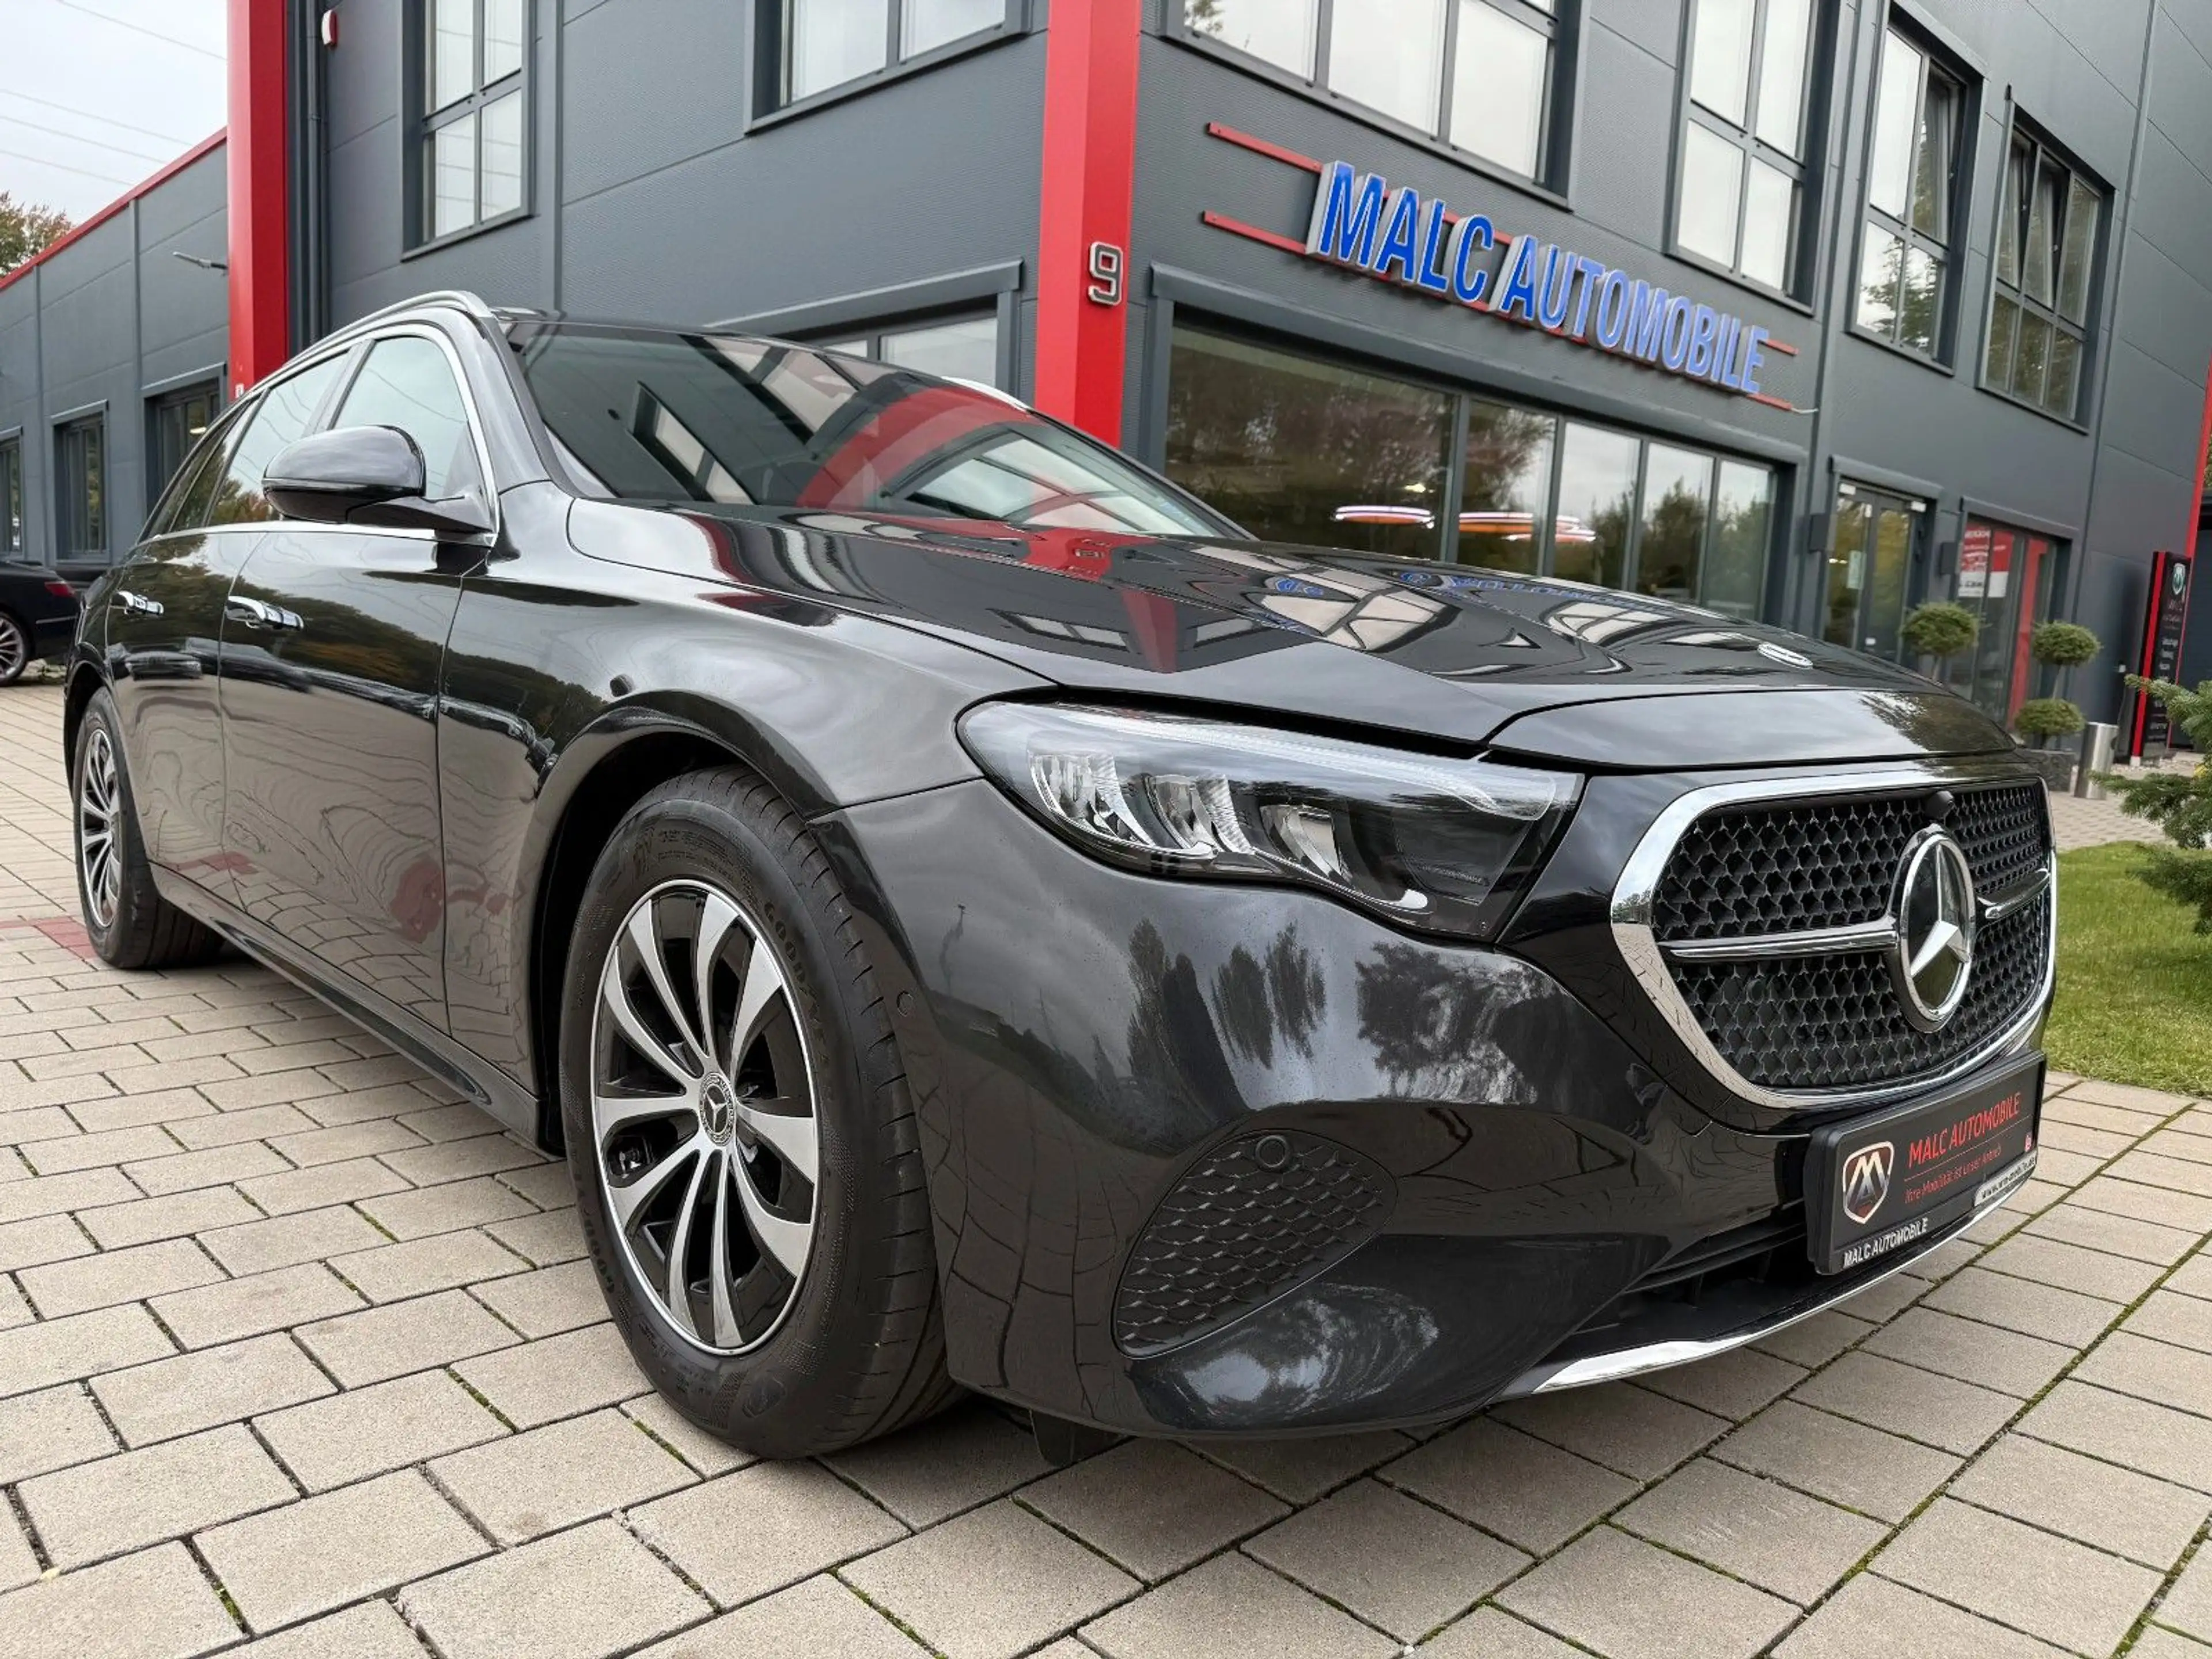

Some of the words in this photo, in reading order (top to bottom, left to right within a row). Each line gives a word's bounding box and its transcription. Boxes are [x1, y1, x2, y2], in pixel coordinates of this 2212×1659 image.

[1088, 241, 1123, 306] 9
[1317, 161, 1495, 302] MALC
[1499, 234, 1770, 394] AUTOMOBILE
[1908, 1127, 1948, 1169] MALC
[1949, 1091, 2021, 1150] AUTOMOBILE
[1843, 1243, 1871, 1268] MALC
[1872, 1217, 1929, 1256] AUTOMOBILE
